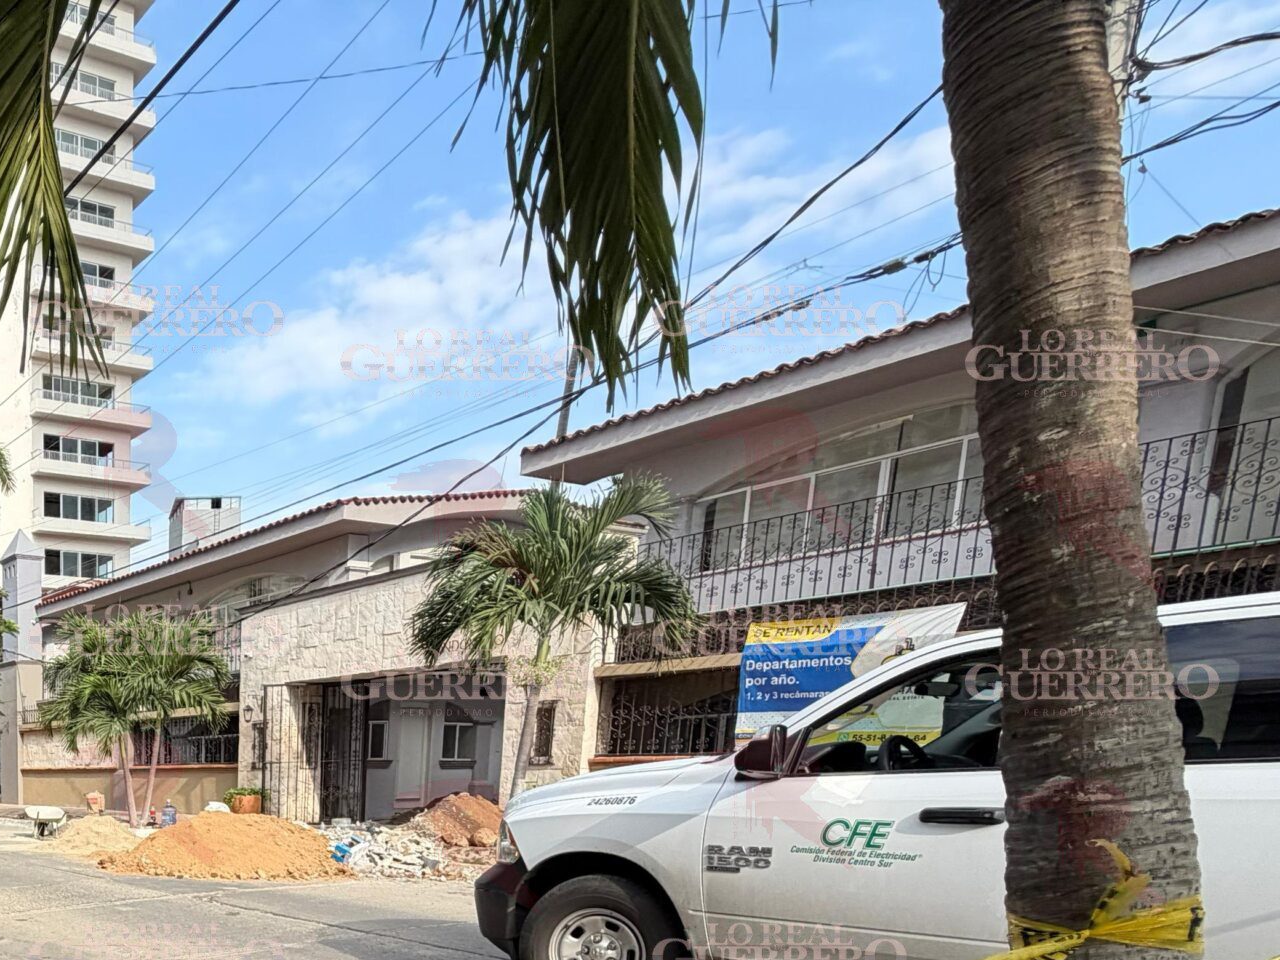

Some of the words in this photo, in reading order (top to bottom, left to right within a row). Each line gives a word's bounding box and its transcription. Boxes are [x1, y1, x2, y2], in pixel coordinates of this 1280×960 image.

[753, 628, 770, 638] SE
[774, 624, 834, 637] RENTAN
[745, 655, 852, 672] Departamentos
[745, 676, 768, 688] por
[770, 674, 800, 686] año.
[756, 691, 763, 699] 2
[764, 692, 771, 701] y
[772, 691, 778, 699] 3
[821, 817, 895, 850] CFE
[706, 844, 773, 857] RAM
[790, 845, 825, 854] Comisión
[826, 848, 855, 857] Federal
[857, 849, 868, 858] de
[706, 856, 772, 869] 1500
[813, 855, 846, 864] División
[848, 857, 875, 867] Centro
[877, 859, 893, 868] Sur
